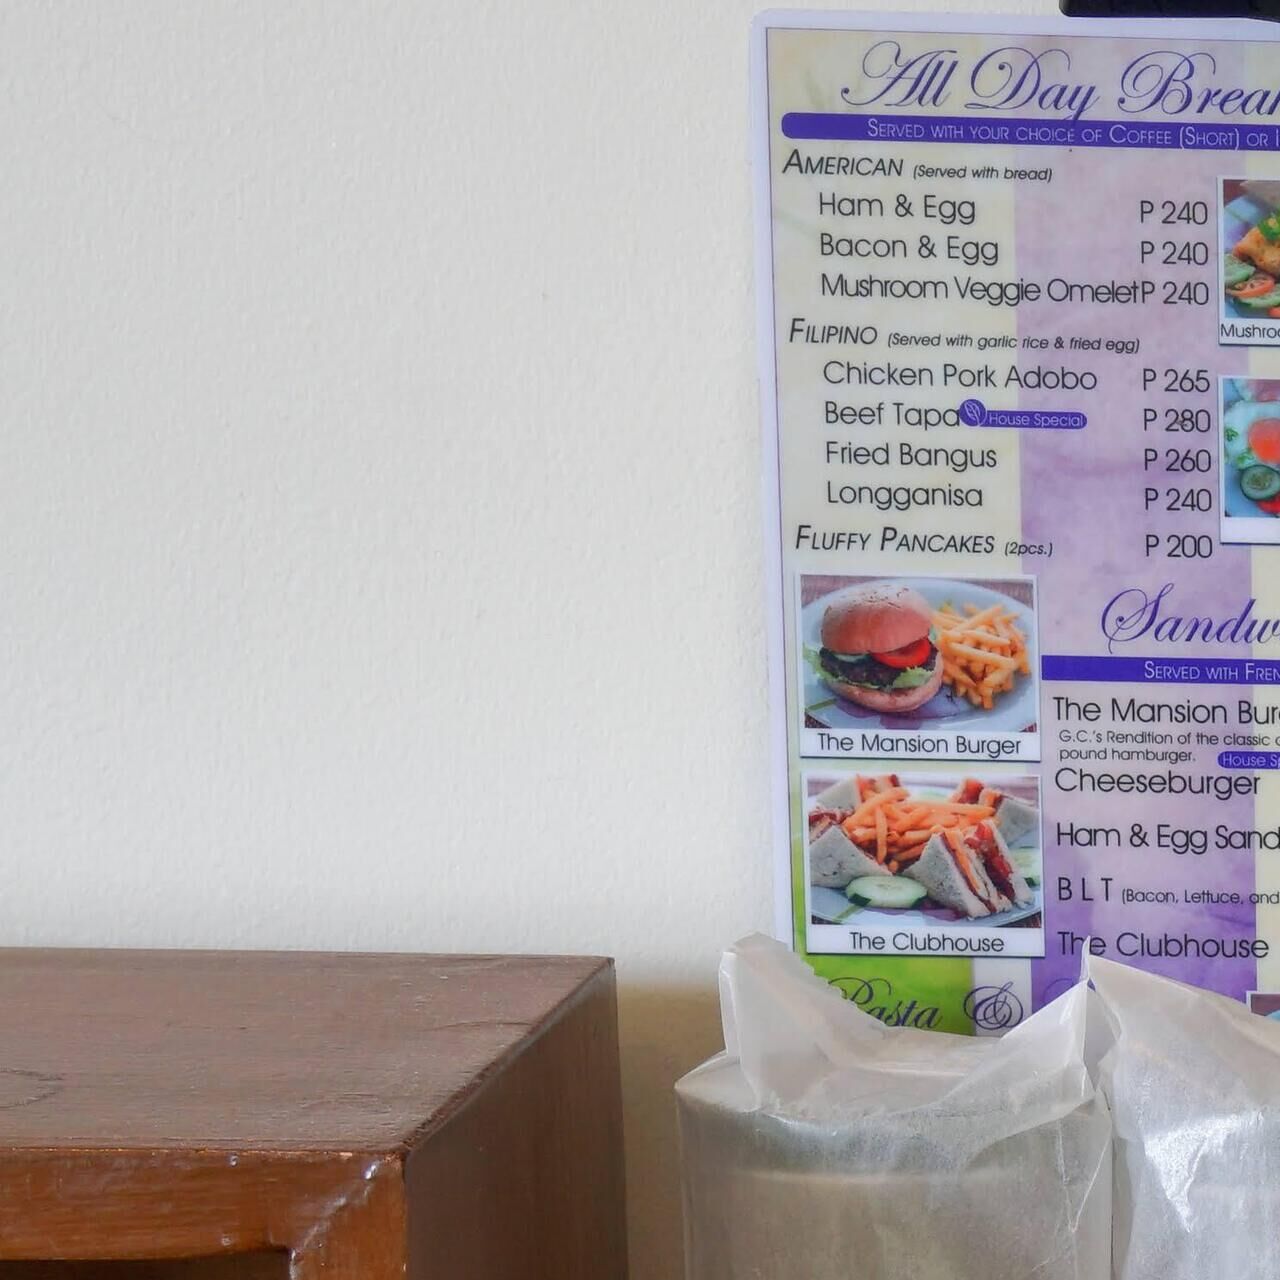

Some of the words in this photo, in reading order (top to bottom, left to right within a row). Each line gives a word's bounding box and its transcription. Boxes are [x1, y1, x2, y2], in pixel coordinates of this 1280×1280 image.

[841, 40, 959, 107] All
[964, 47, 1101, 120] Day
[913, 164, 966, 180] (Served
[971, 165, 999, 180] with
[1004, 167, 1052, 183] bread)
[819, 193, 883, 217] Ham
[895, 194, 914, 217] &
[924, 195, 975, 224] Egg
[820, 234, 907, 259] Bacon
[918, 236, 937, 260] &
[947, 238, 999, 267] Egg
[821, 273, 948, 299] Mushroom
[954, 276, 1041, 307] Veggie
[1047, 279, 1139, 304] Omelet
[887, 332, 940, 348] (Served
[945, 333, 973, 348] with
[978, 334, 1018, 351] garlic
[1022, 336, 1049, 349] rice
[1054, 337, 1065, 349] &
[1070, 337, 1101, 350] fried
[1106, 338, 1140, 355] egg)
[823, 361, 933, 387] Chicken
[944, 363, 997, 388] Pork
[1004, 365, 1098, 390] Adobo
[825, 401, 883, 425] Beef
[892, 402, 959, 430] Tapa
[825, 441, 890, 465] Fried
[899, 443, 997, 473] Bangus
[827, 481, 983, 511] Longganisa
[1004, 541, 1053, 558] (2pcs.)
[1053, 697, 1101, 722] The
[1111, 698, 1228, 724] Mansion
[817, 732, 853, 754] The
[860, 733, 948, 756] Mansion
[954, 734, 1021, 760] Burger
[1107, 731, 1173, 745] Rendition
[1177, 732, 1193, 745] of
[1197, 733, 1219, 746] the
[1223, 733, 1270, 746] classic
[1059, 748, 1107, 762] pound
[1112, 748, 1196, 764] hamburger.
[1055, 768, 1260, 801] Cheeseburger
[1056, 823, 1121, 847] Ham
[1129, 823, 1150, 847] &
[1158, 824, 1207, 854] Egg
[850, 932, 886, 951] The
[893, 933, 1005, 952] Clubhouse
[1058, 931, 1106, 957] The
[1116, 932, 1269, 959] Clubhouse
